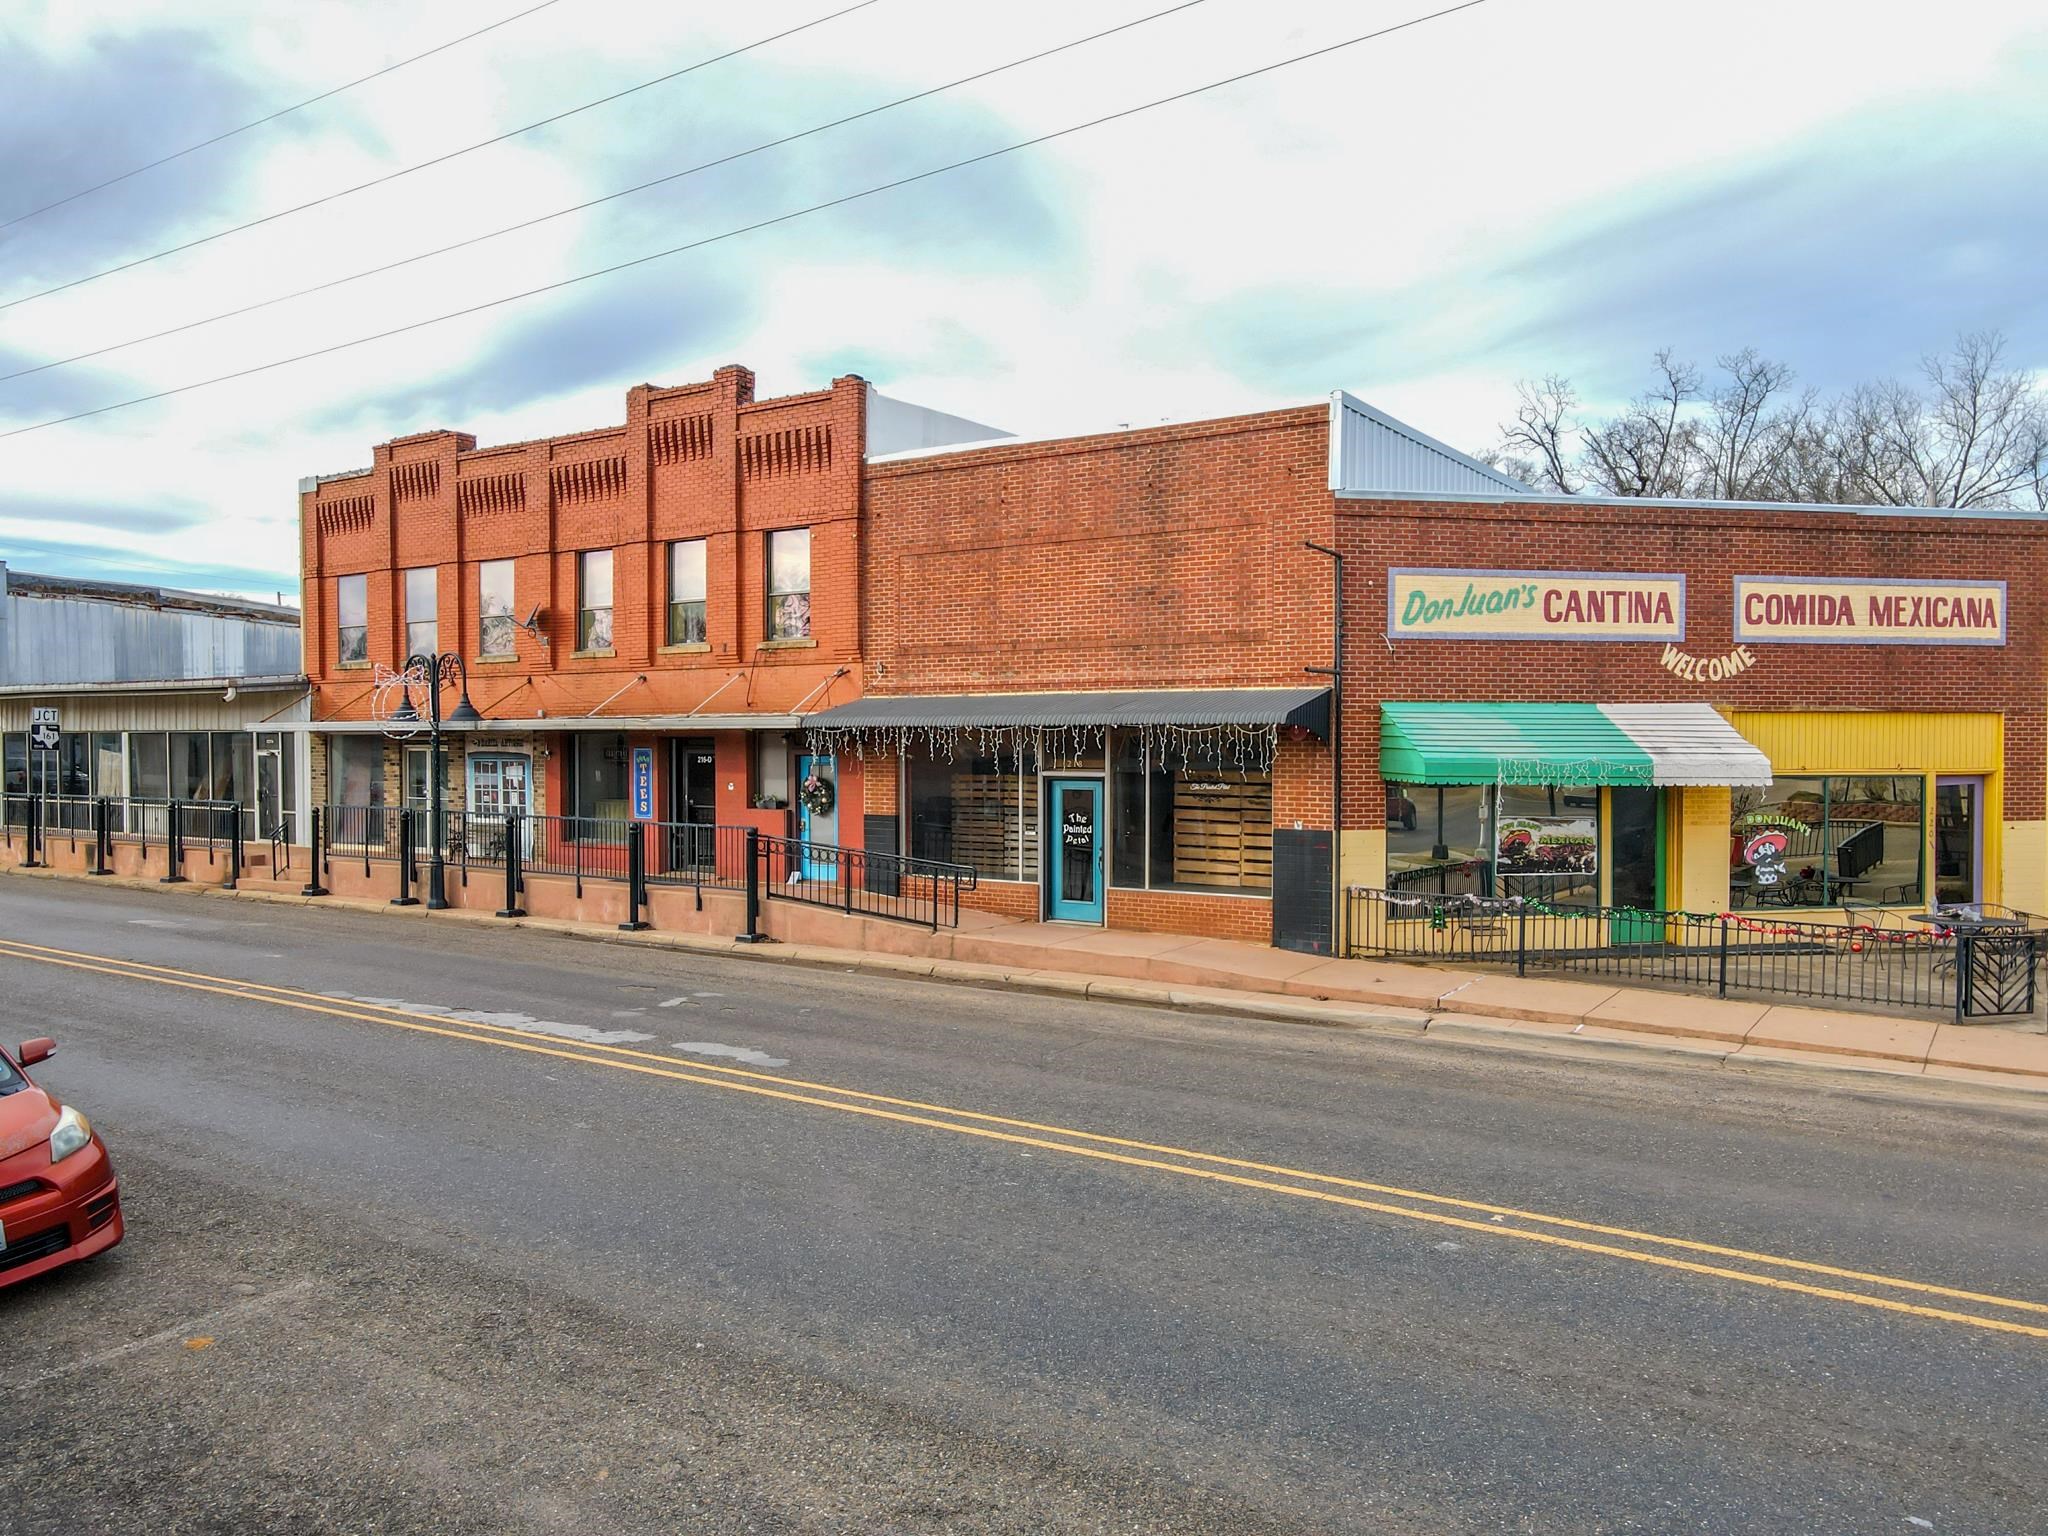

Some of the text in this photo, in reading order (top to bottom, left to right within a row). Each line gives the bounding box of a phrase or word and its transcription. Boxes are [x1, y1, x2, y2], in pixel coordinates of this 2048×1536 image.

[1543, 589, 1675, 624] CANTINA
[1745, 593, 1998, 629] COMIDA MEXICANA
[1660, 642, 1757, 682] WELCOME
[34, 710, 57, 721] JCT
[640, 763, 648, 812] TEES
[1068, 813, 1088, 823] The
[1746, 814, 1812, 837] DON JUAN'S
[1063, 824, 1093, 834] Painted
[1065, 835, 1090, 845] Petal
[1539, 836, 1594, 845] MEXICAN
